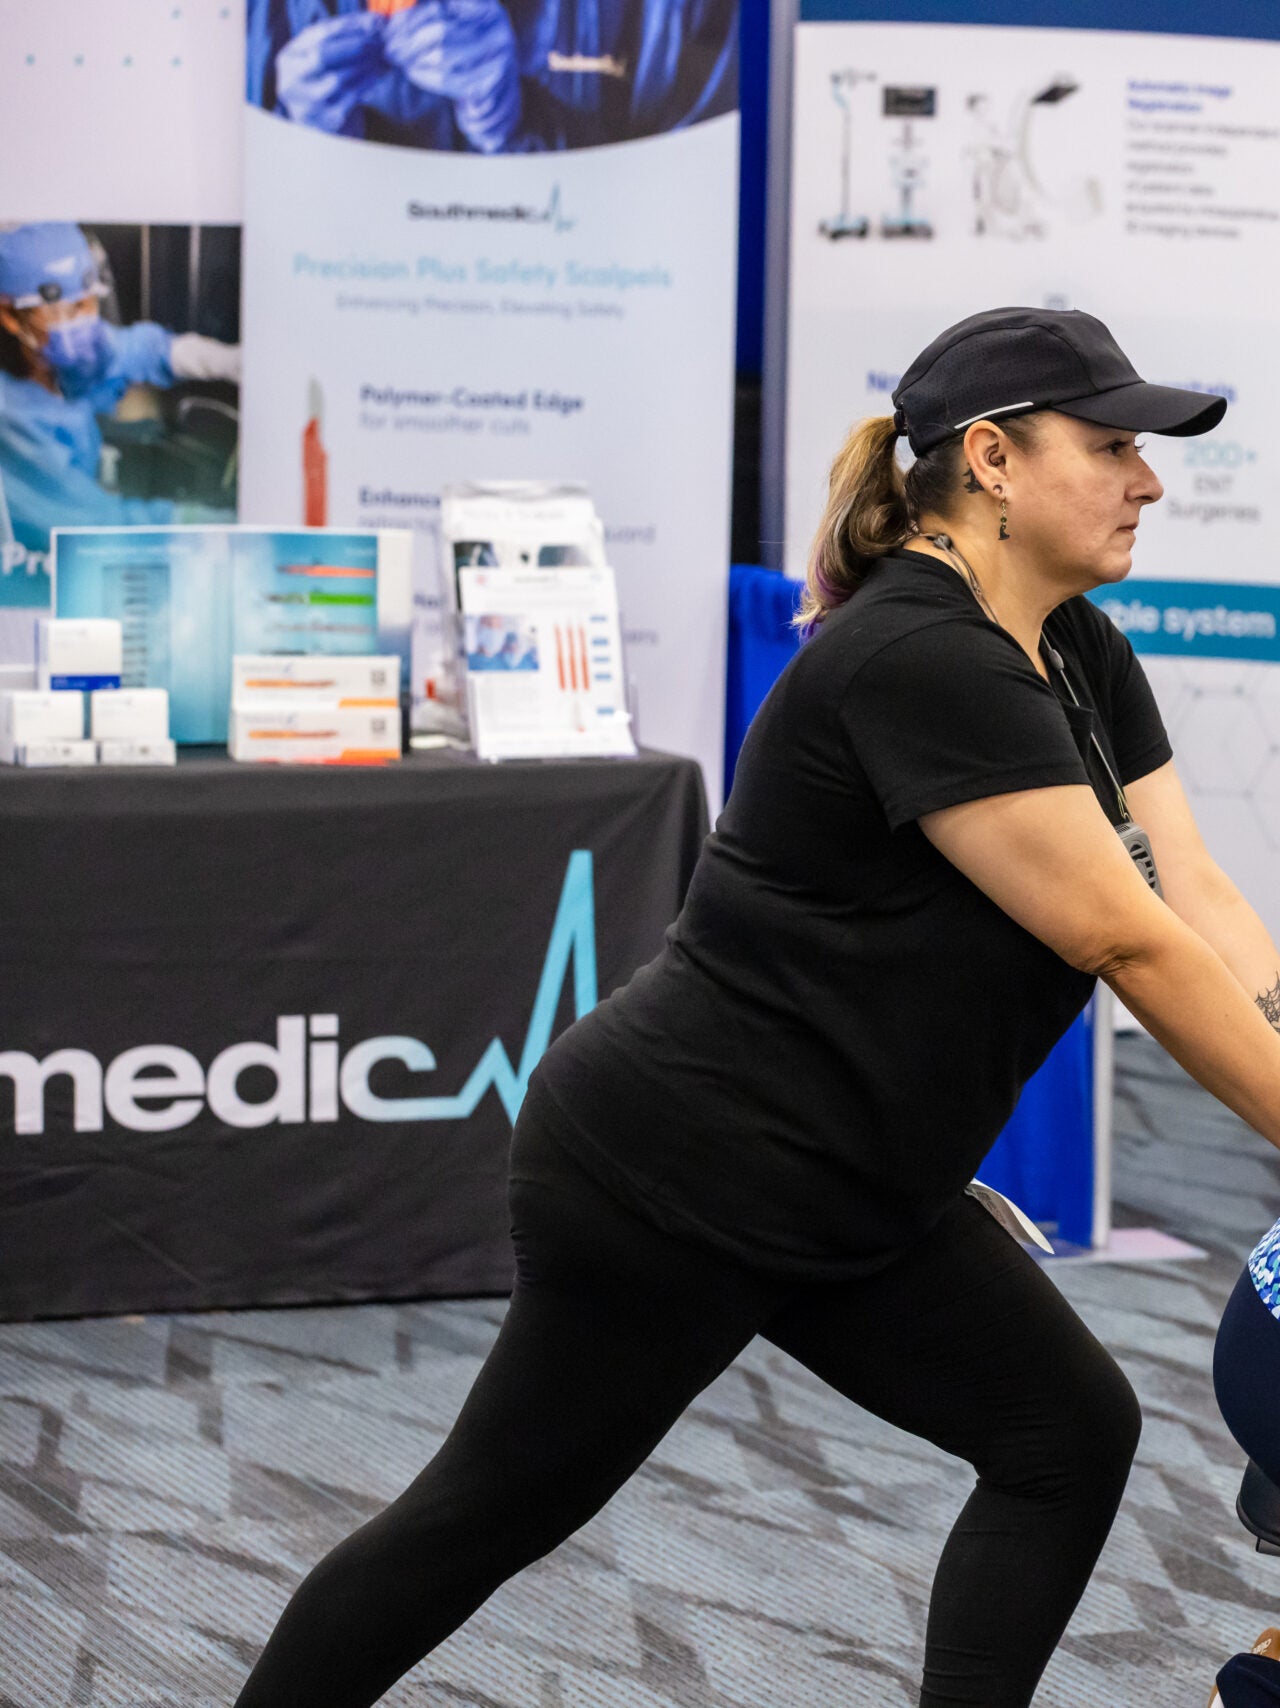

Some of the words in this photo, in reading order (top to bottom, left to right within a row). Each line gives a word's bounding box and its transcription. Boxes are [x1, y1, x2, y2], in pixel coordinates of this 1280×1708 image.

[293, 252, 408, 281] Precision
[417, 256, 467, 283] Plus
[477, 257, 557, 288] Safety
[565, 260, 671, 290] Scalpels
[359, 385, 528, 411] Polymer-Coated
[533, 389, 584, 416] Edge
[358, 411, 386, 429] for
[392, 415, 483, 434] smoother
[1163, 606, 1276, 642] system
